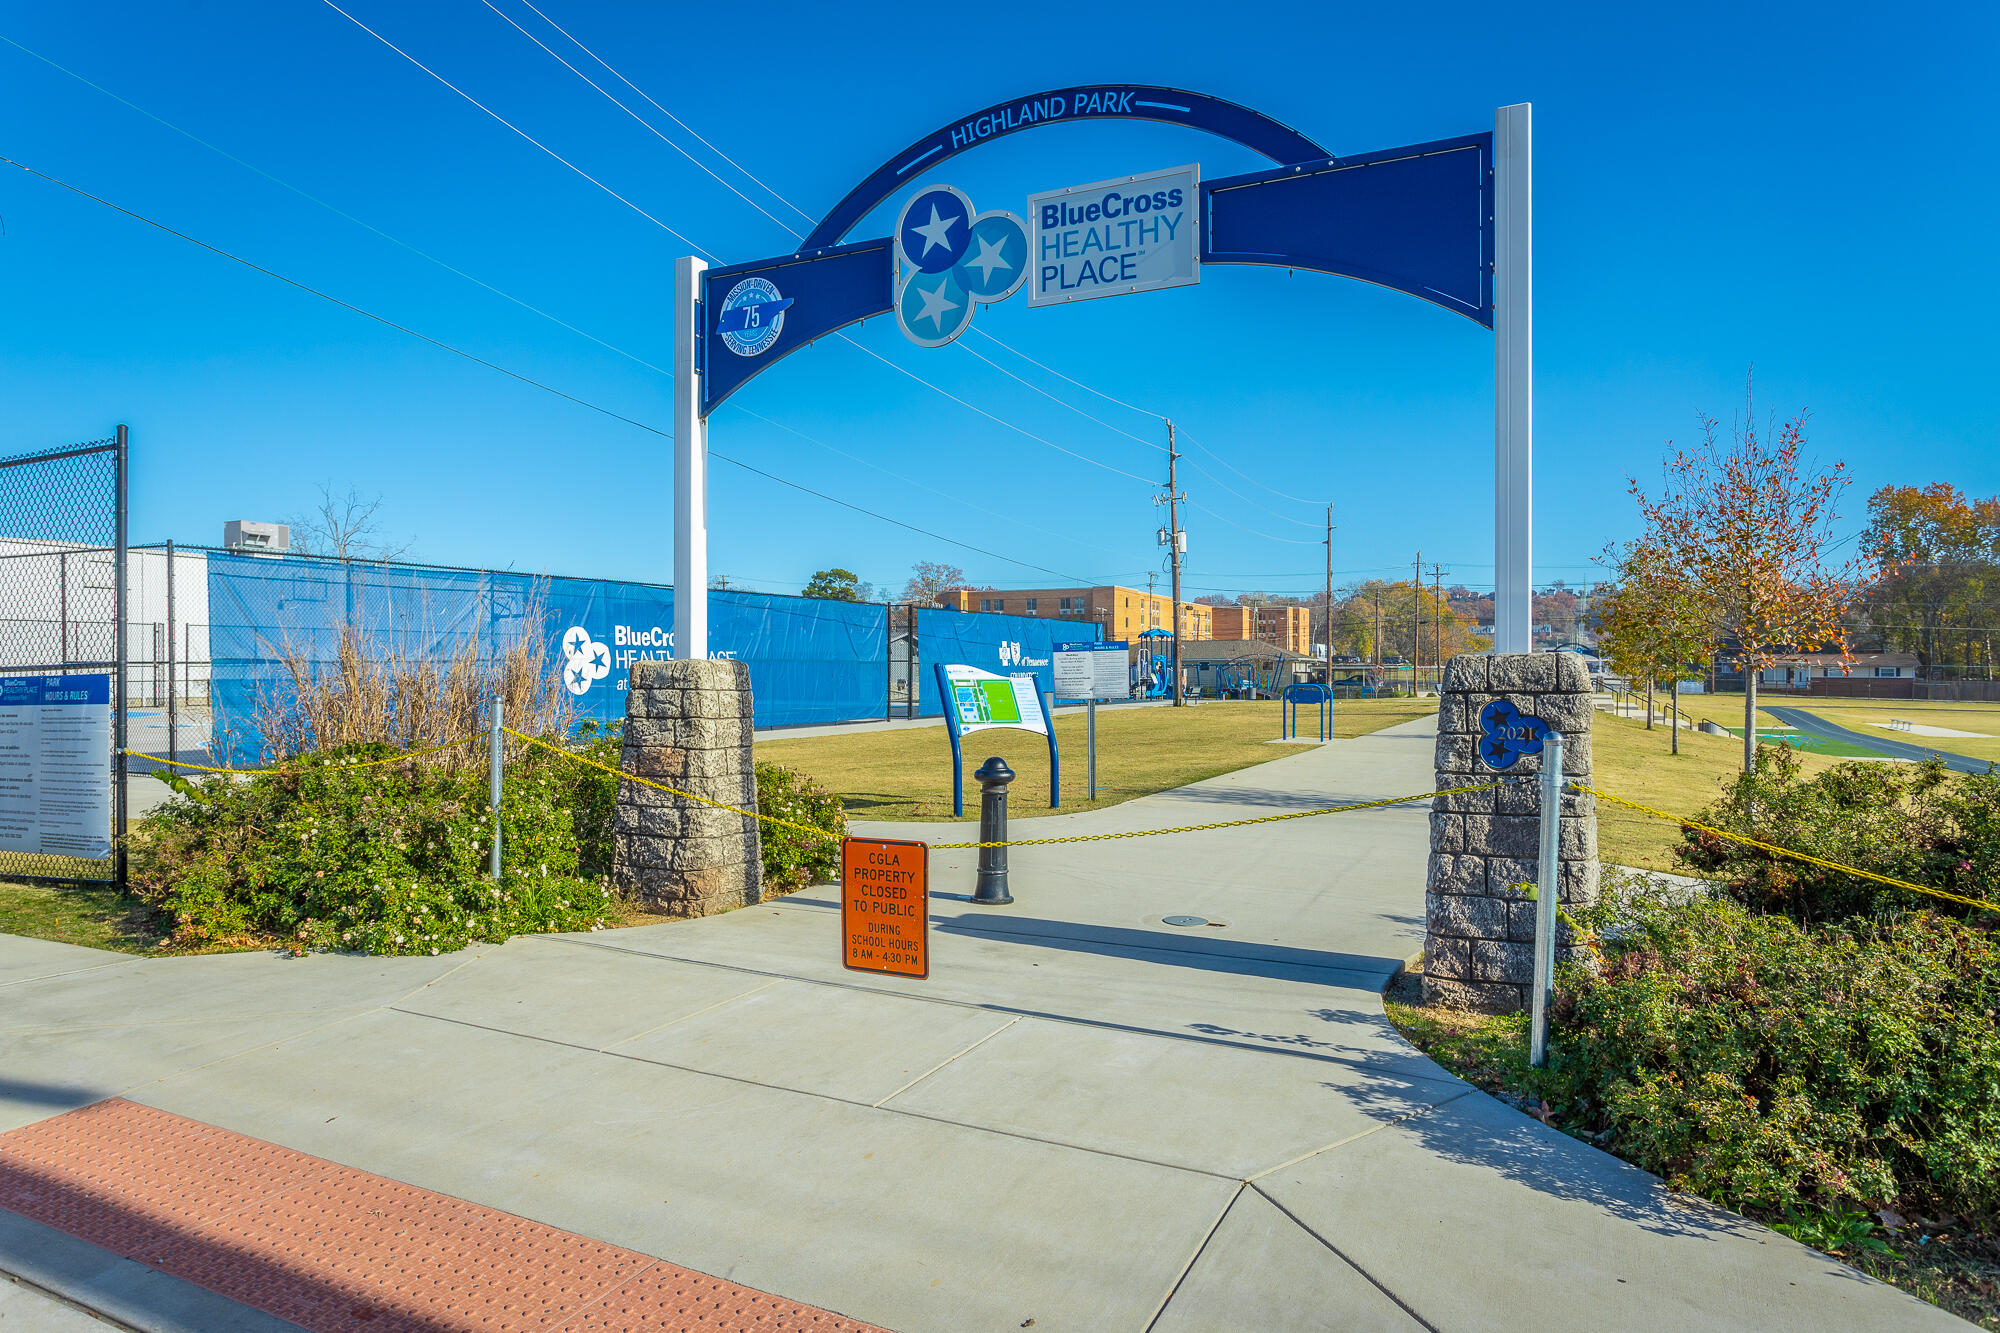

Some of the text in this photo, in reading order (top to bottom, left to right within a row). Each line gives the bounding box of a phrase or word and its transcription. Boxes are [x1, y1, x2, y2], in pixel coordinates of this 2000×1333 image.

[951, 91, 1134, 149] HIGHLAND PARK
[1042, 188, 1183, 230] BlueCross
[1042, 211, 1184, 261] HEALTHY
[1042, 252, 1137, 292] PLACE
[743, 305, 760, 328] 75
[724, 328, 779, 355] SERVING TENNESSEE
[615, 625, 674, 647] BlueCro
[45, 678, 61, 687] PARK
[616, 678, 628, 691] at
[45, 690, 89, 701] HOURS & RULES
[1497, 726, 1533, 740] 2021
[869, 852, 900, 866] CGLA
[854, 868, 916, 884] PROPERTY
[861, 884, 907, 900] CLOSED
[854, 900, 915, 917] TO PUBLIC
[868, 923, 900, 935] DURING
[852, 934, 919, 951] SCHOOL HOURS
[852, 948, 858, 958] 8
[861, 949, 873, 960] AM
[883, 952, 901, 963] 4:30
[905, 954, 918, 965] PM
